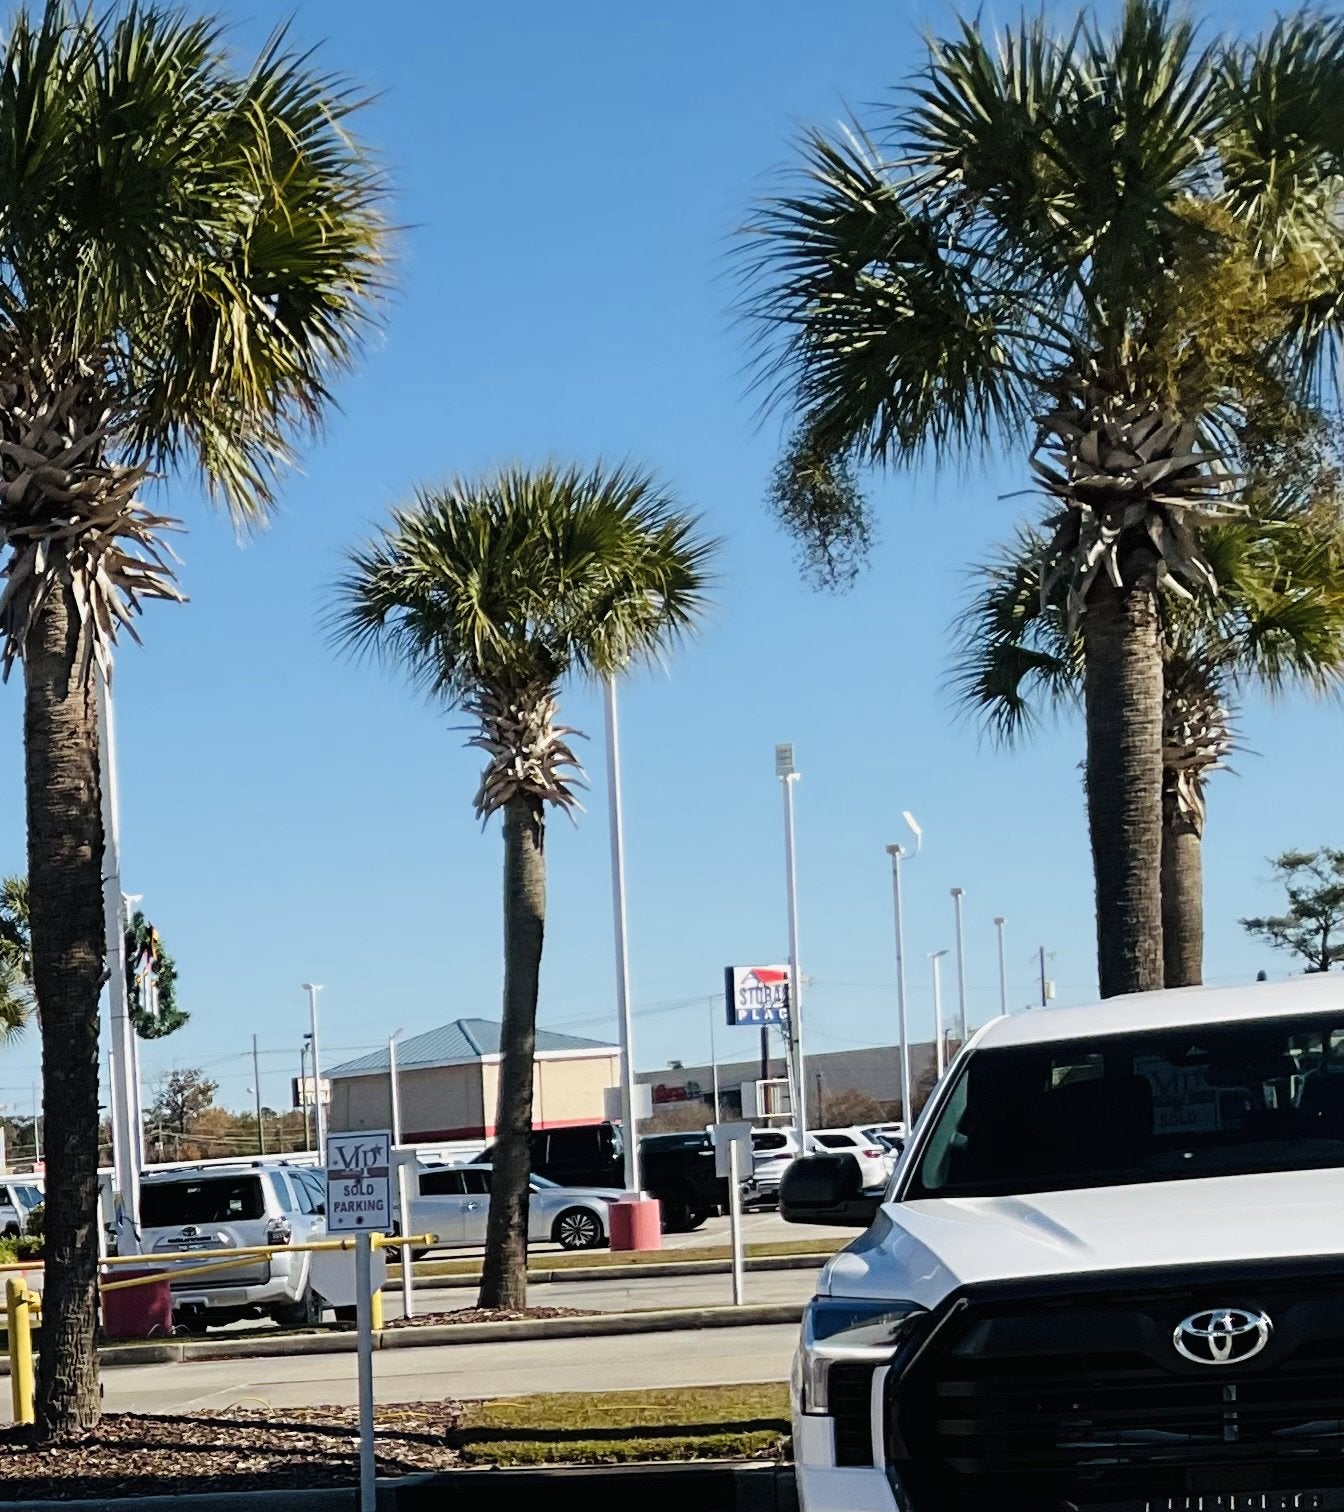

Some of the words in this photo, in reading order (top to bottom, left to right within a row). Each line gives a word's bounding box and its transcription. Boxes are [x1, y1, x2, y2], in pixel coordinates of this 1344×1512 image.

[738, 1008, 789, 1021] PLAC
[344, 1184, 374, 1196] SOLD
[334, 1199, 384, 1213] PARKING
